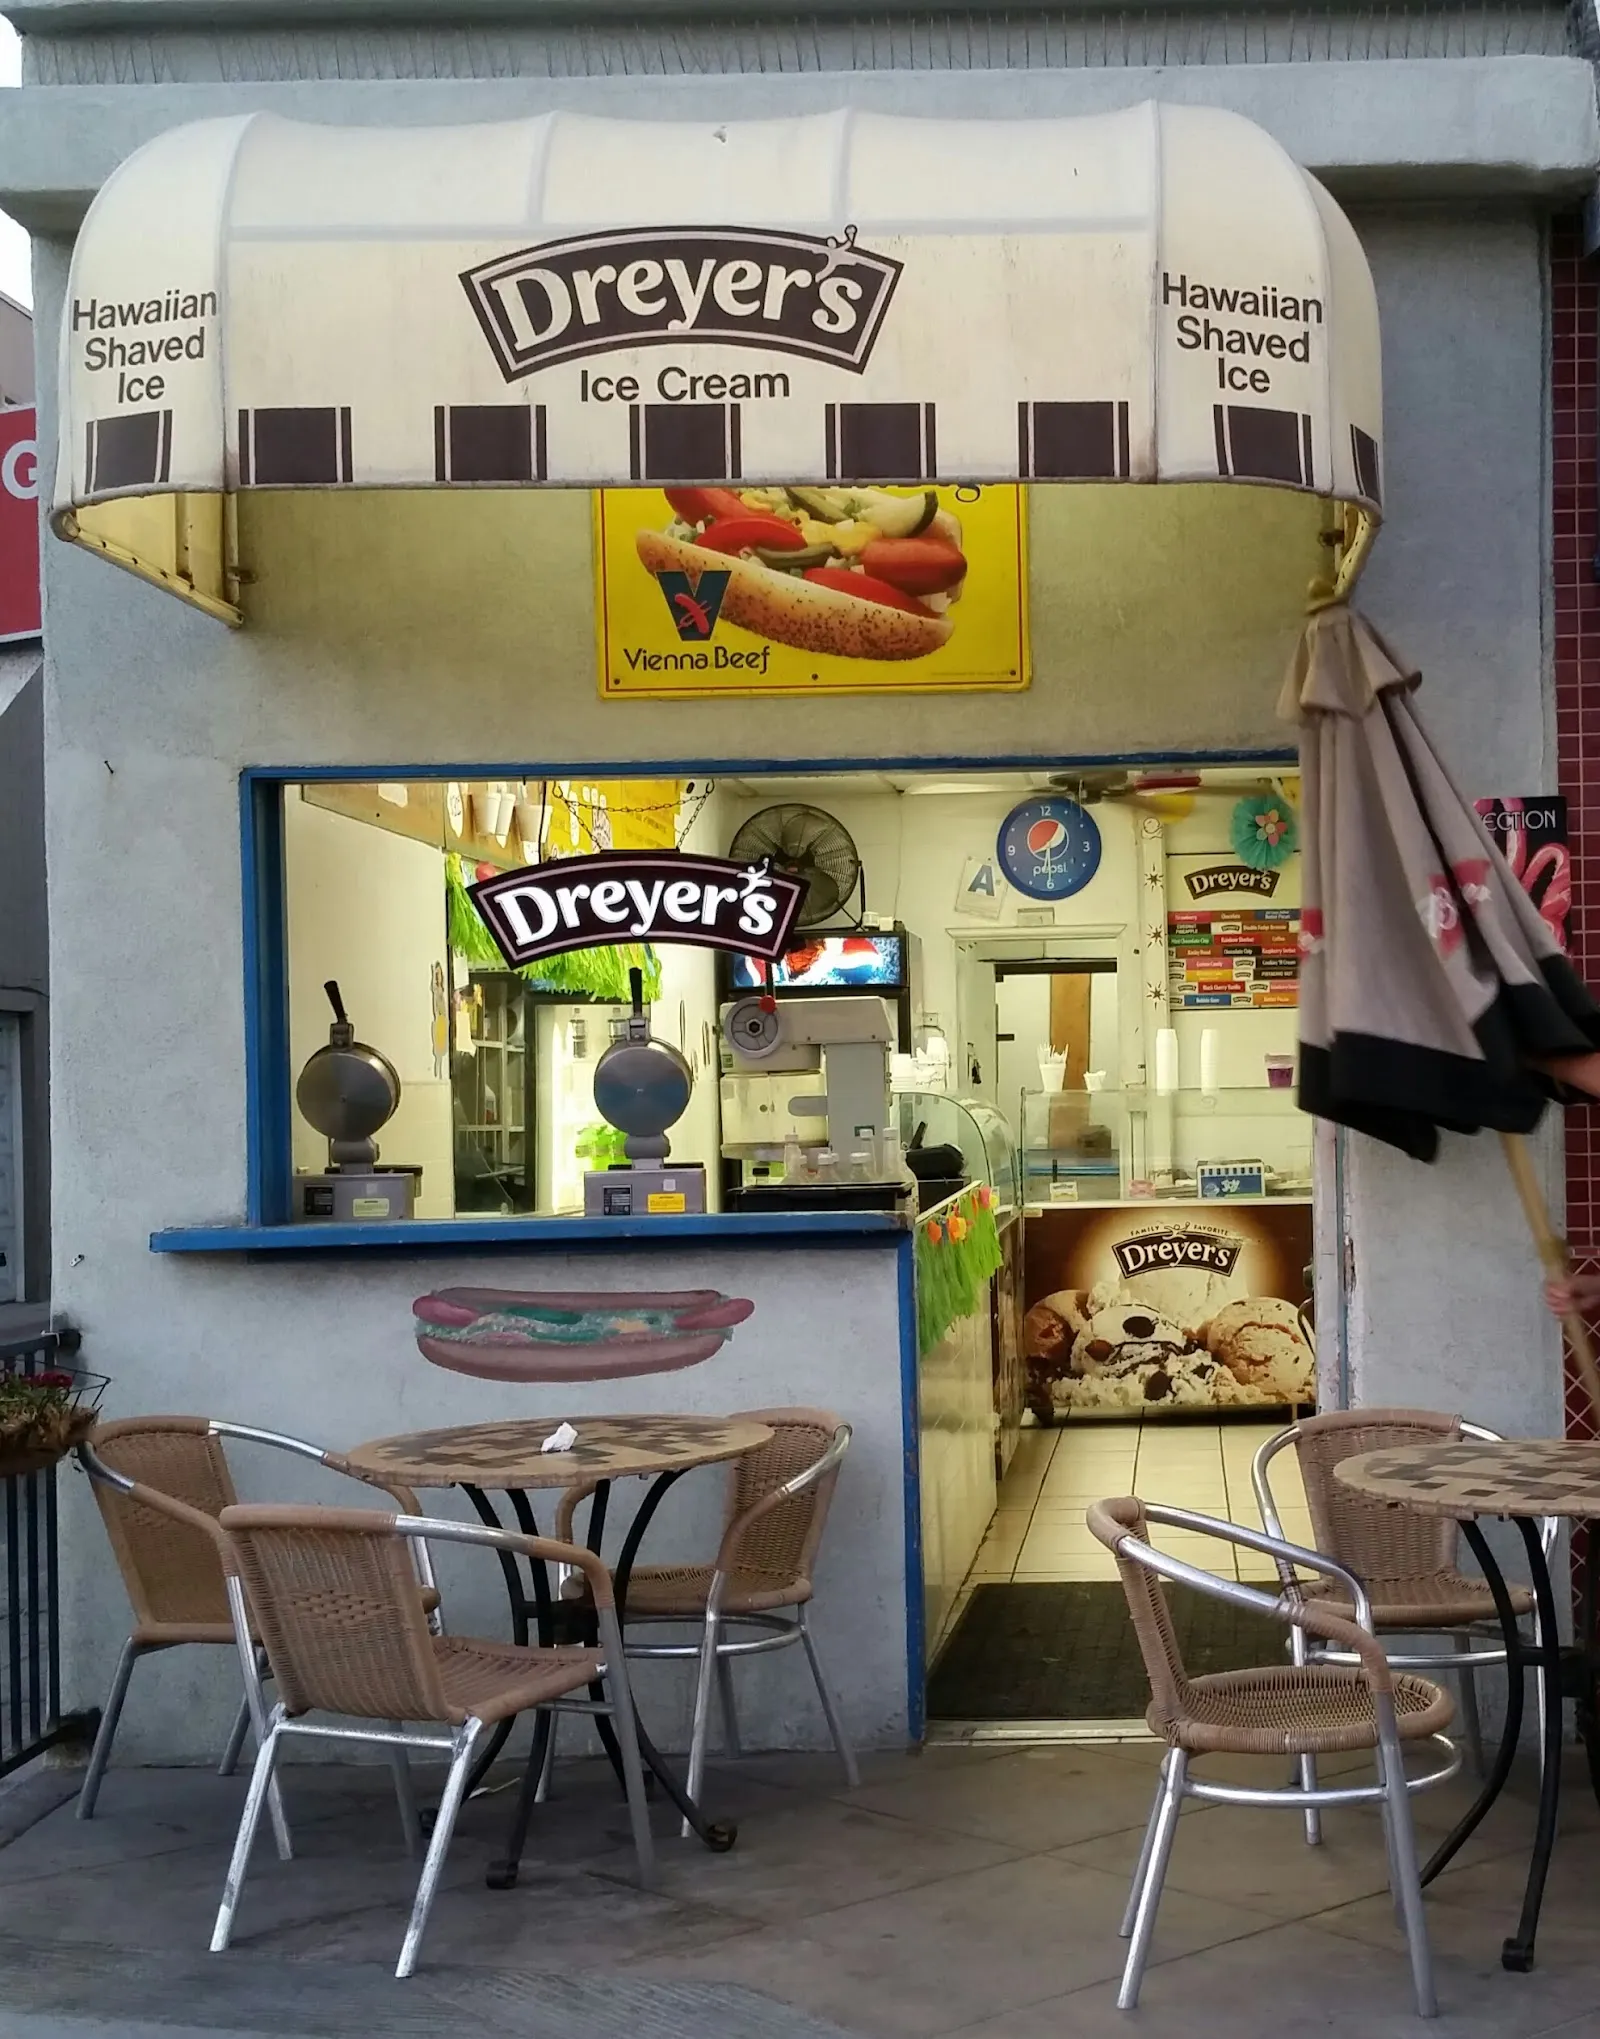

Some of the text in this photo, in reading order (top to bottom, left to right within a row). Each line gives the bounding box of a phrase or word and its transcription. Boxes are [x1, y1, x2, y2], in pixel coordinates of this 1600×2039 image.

[72, 290, 217, 332] Hawaiian
[490, 258, 864, 352] Dreyer's
[1162, 272, 1323, 324] Hawaiian
[84, 326, 206, 371] Shaved
[1176, 315, 1310, 363] Shaved
[117, 372, 166, 404] Ice
[580, 366, 790, 402] Ice Cream
[1217, 357, 1270, 393] Ice
[623, 646, 770, 675] Vienna Beef
[1040, 805, 1051, 817] 12
[1481, 809, 1556, 832] ECTION
[1007, 844, 1016, 856] 9
[1083, 841, 1091, 852] 3
[967, 864, 995, 897] A
[1190, 872, 1272, 894] Dreyer's
[493, 880, 778, 947] Dreyer's
[1130, 1224, 1229, 1237] FAMILY FAVORITE
